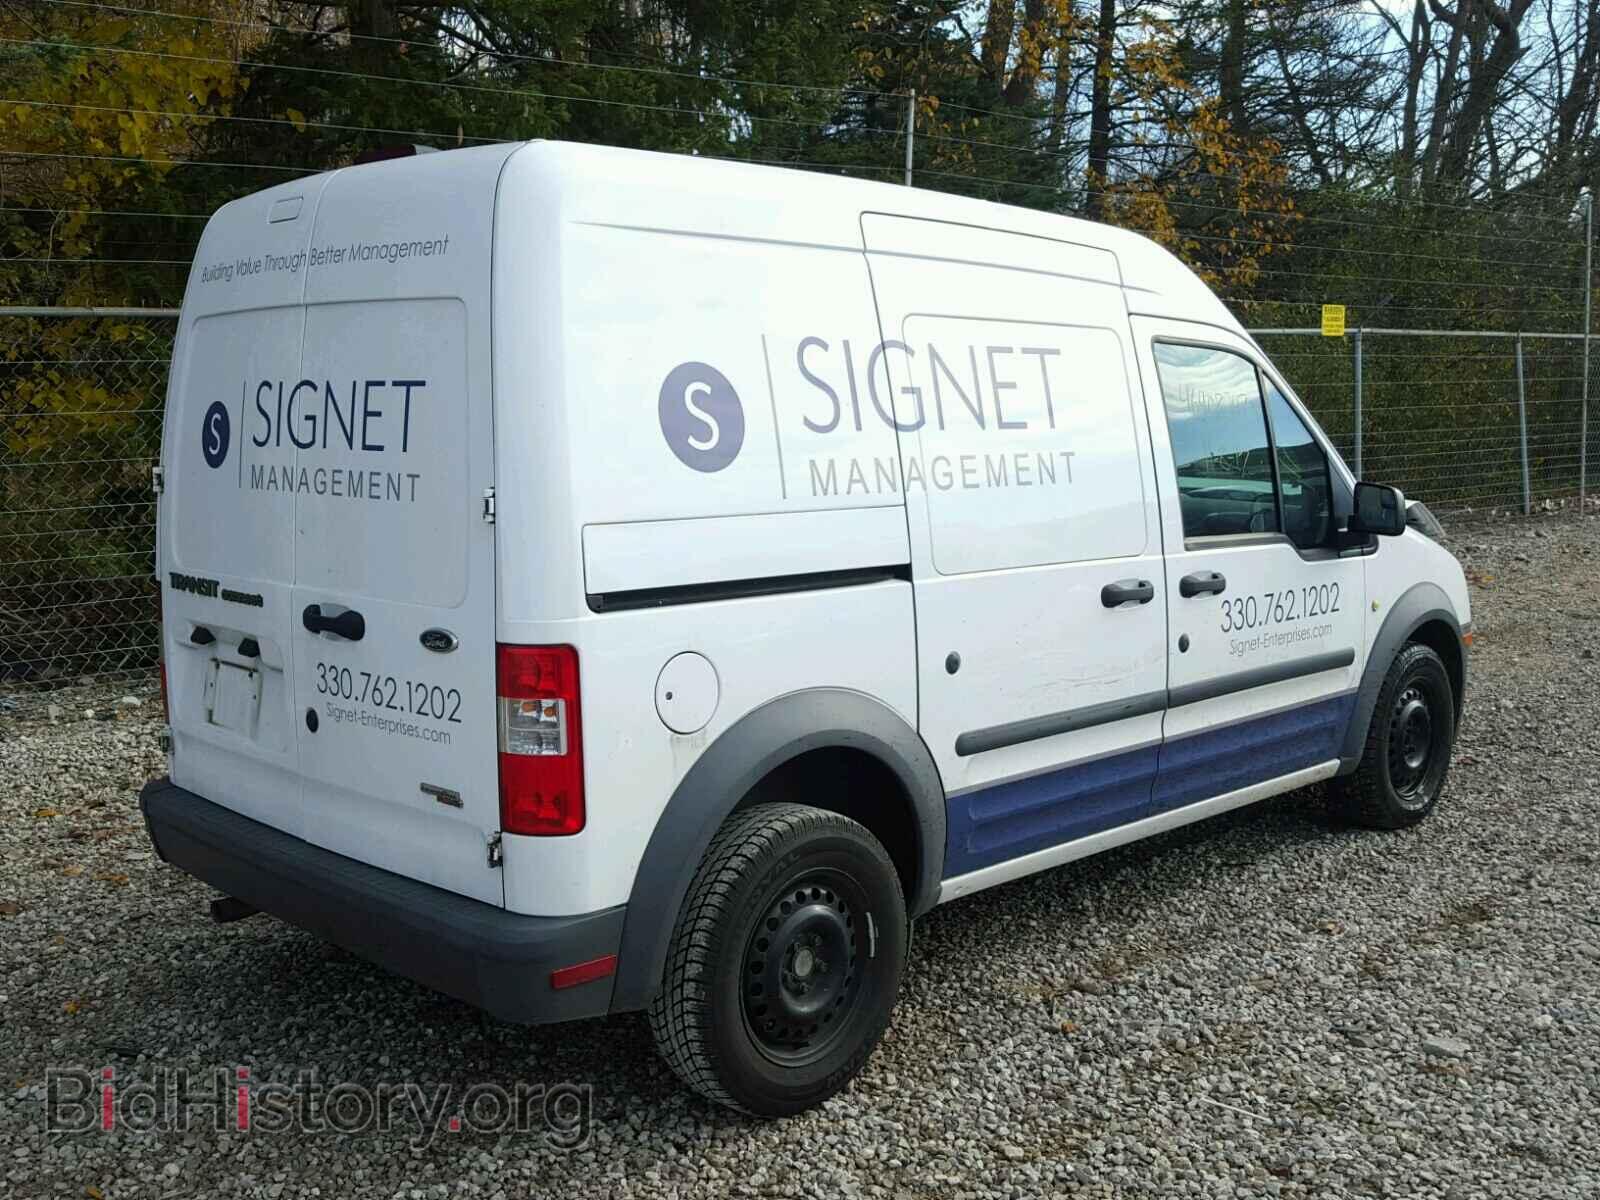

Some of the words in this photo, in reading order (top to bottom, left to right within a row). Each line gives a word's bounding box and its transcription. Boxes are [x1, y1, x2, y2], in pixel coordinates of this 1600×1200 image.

[201, 262, 234, 283] Building
[236, 256, 262, 277] Value
[264, 247, 307, 273] Through
[309, 245, 347, 266] Better
[348, 233, 449, 263] Management
[795, 335, 1061, 434] SIGNET
[252, 379, 426, 453] SIGNET
[251, 464, 421, 502] MANAGEMENT
[808, 450, 1076, 497] MANAGEMENT
[168, 571, 220, 598] TRANSIT
[1220, 581, 1341, 633] 330.762.1202
[1229, 622, 1333, 657] Signet-Enterprises.com
[316, 661, 463, 724] 330.762.1202
[326, 702, 452, 745] Signet-Enterprises.com
